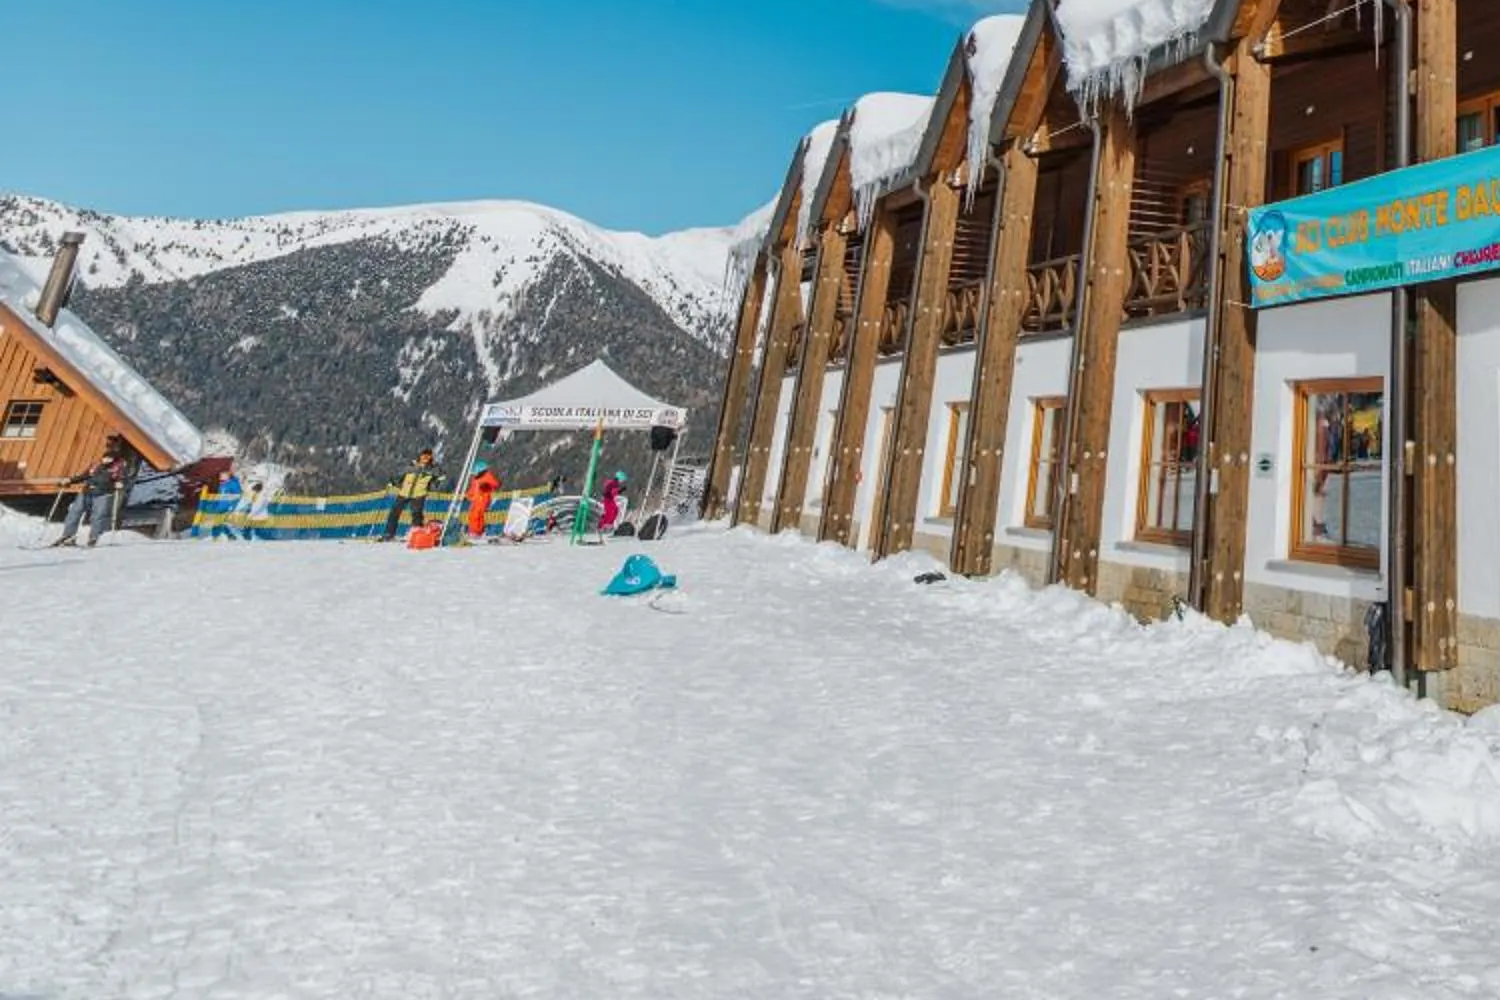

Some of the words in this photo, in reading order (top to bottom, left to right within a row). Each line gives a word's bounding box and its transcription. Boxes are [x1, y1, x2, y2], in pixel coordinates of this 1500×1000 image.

[1326, 208, 1369, 248] CLUB
[1375, 190, 1450, 236] MONTE
[531, 407, 573, 417] SCUOLA
[575, 407, 621, 418] ITALIANA
